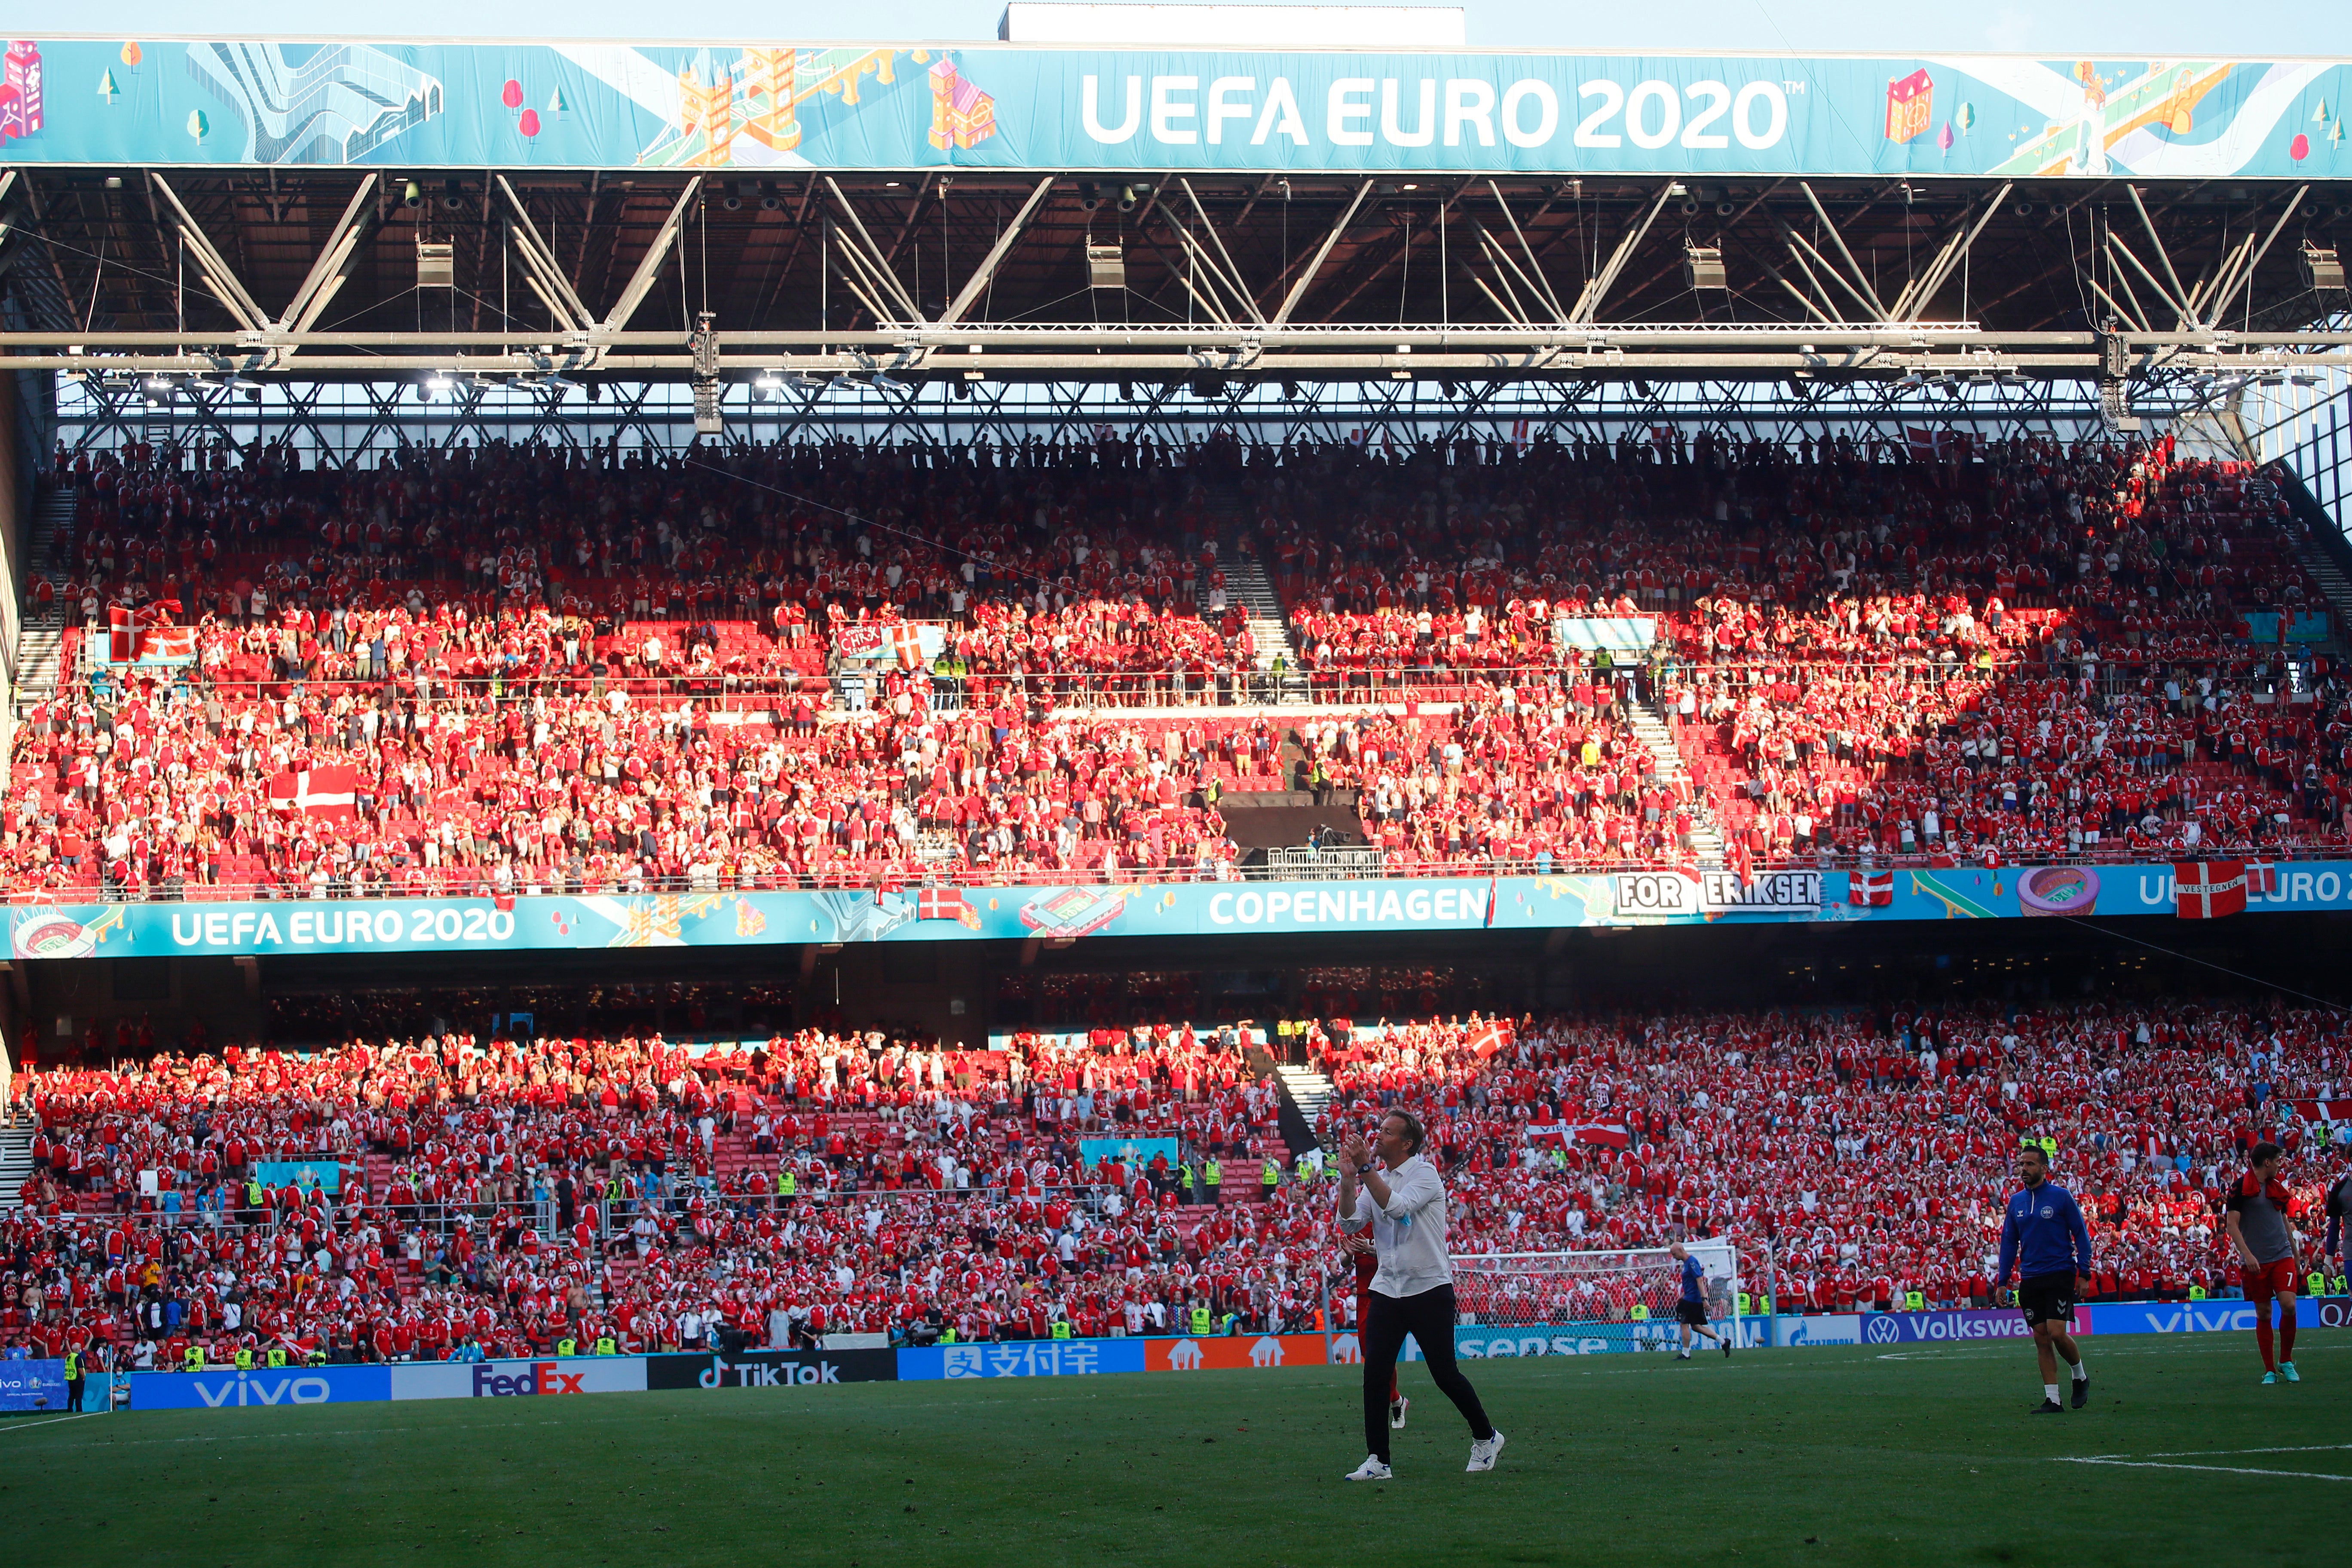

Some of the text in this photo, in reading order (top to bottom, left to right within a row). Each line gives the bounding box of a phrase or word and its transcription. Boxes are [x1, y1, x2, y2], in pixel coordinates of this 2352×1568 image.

[1083, 75, 1308, 145] UEFA
[1327, 78, 1559, 148] EURO
[1577, 79, 1787, 149] 2020
[1988, 854, 1995, 865] 10
[1620, 873, 1819, 907] FOR ERIKSEN
[2183, 879, 2238, 894] VESTEGNEN
[1209, 888, 1487, 924] COPENHAGEN
[172, 908, 515, 946] UEFA EURO 2020
[1600, 1155, 1610, 1164] 10
[568, 1264, 578, 1273] 10
[2287, 1272, 2293, 1287] 7
[1910, 1309, 2081, 1340] Volkswan
[735, 1359, 839, 1387] TikTok
[987, 1341, 1099, 1376] 支付宝
[193, 1371, 330, 1407] vivo
[473, 1362, 585, 1397] FedEx
